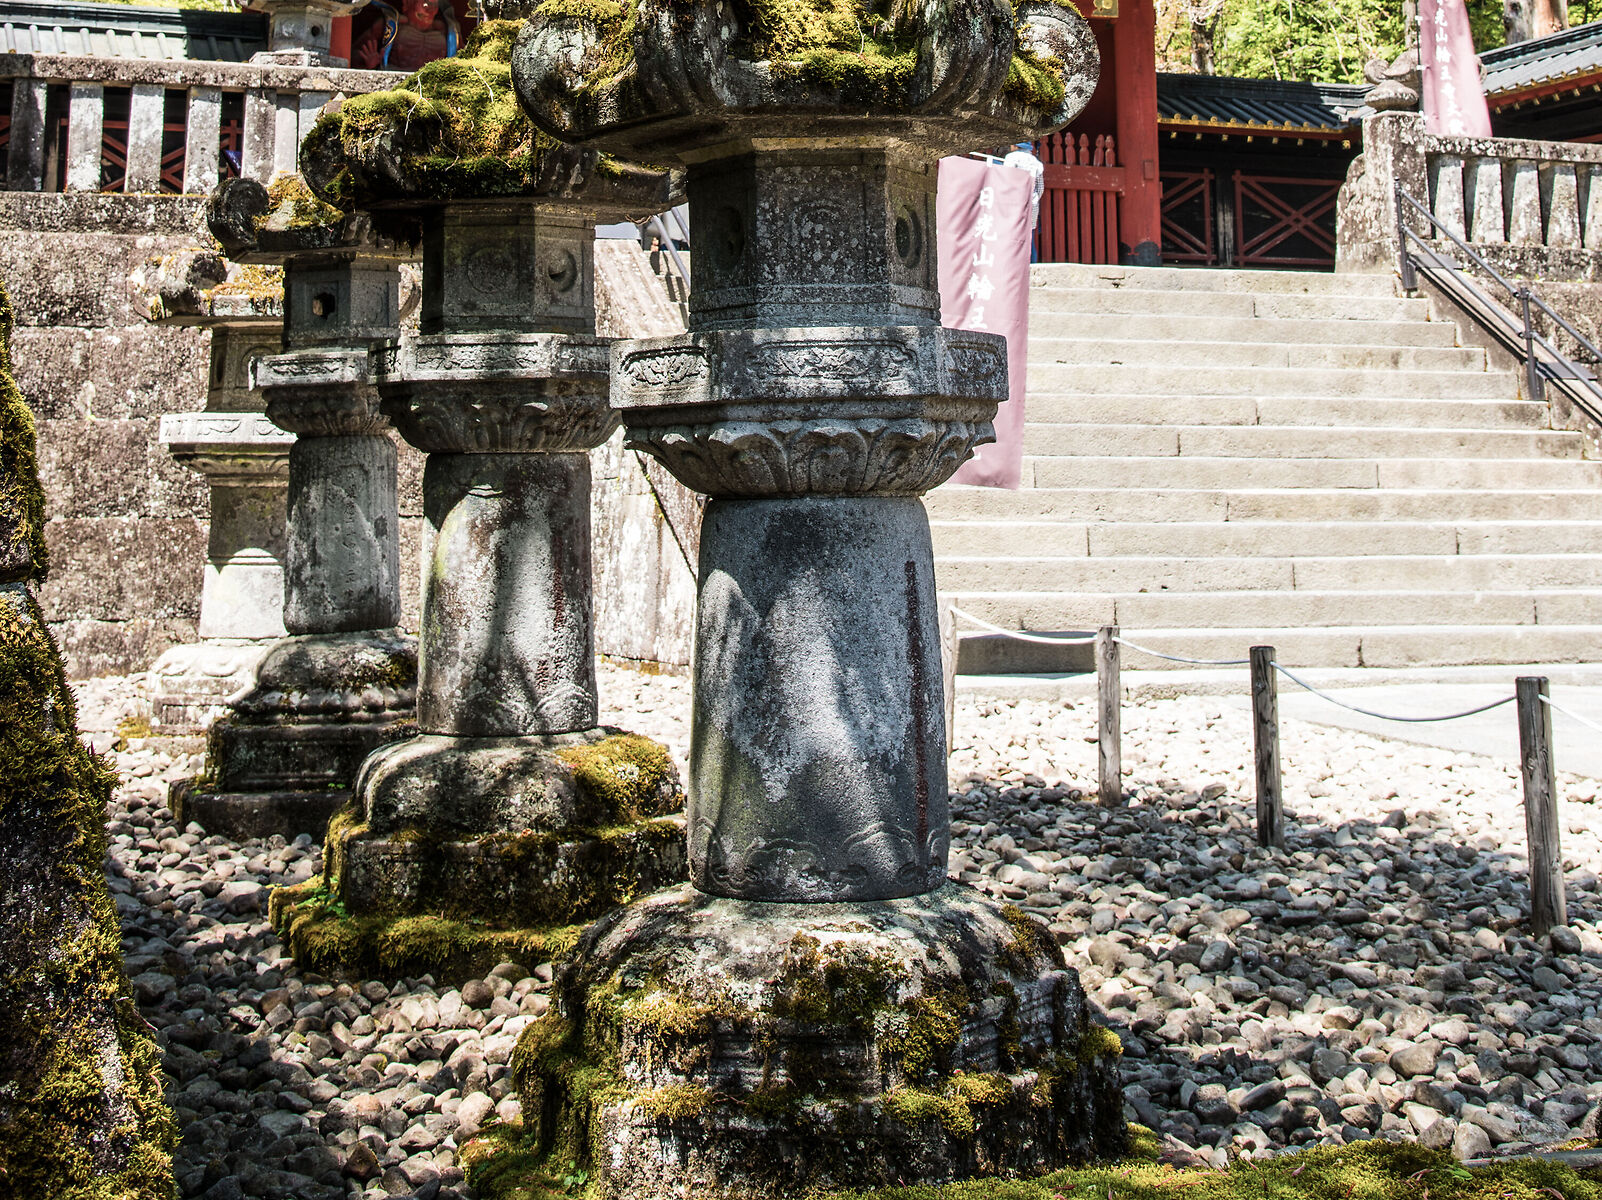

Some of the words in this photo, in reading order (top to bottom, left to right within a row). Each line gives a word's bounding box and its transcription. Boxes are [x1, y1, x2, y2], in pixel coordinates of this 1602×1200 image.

[967, 186, 998, 330] 日光山輪王
